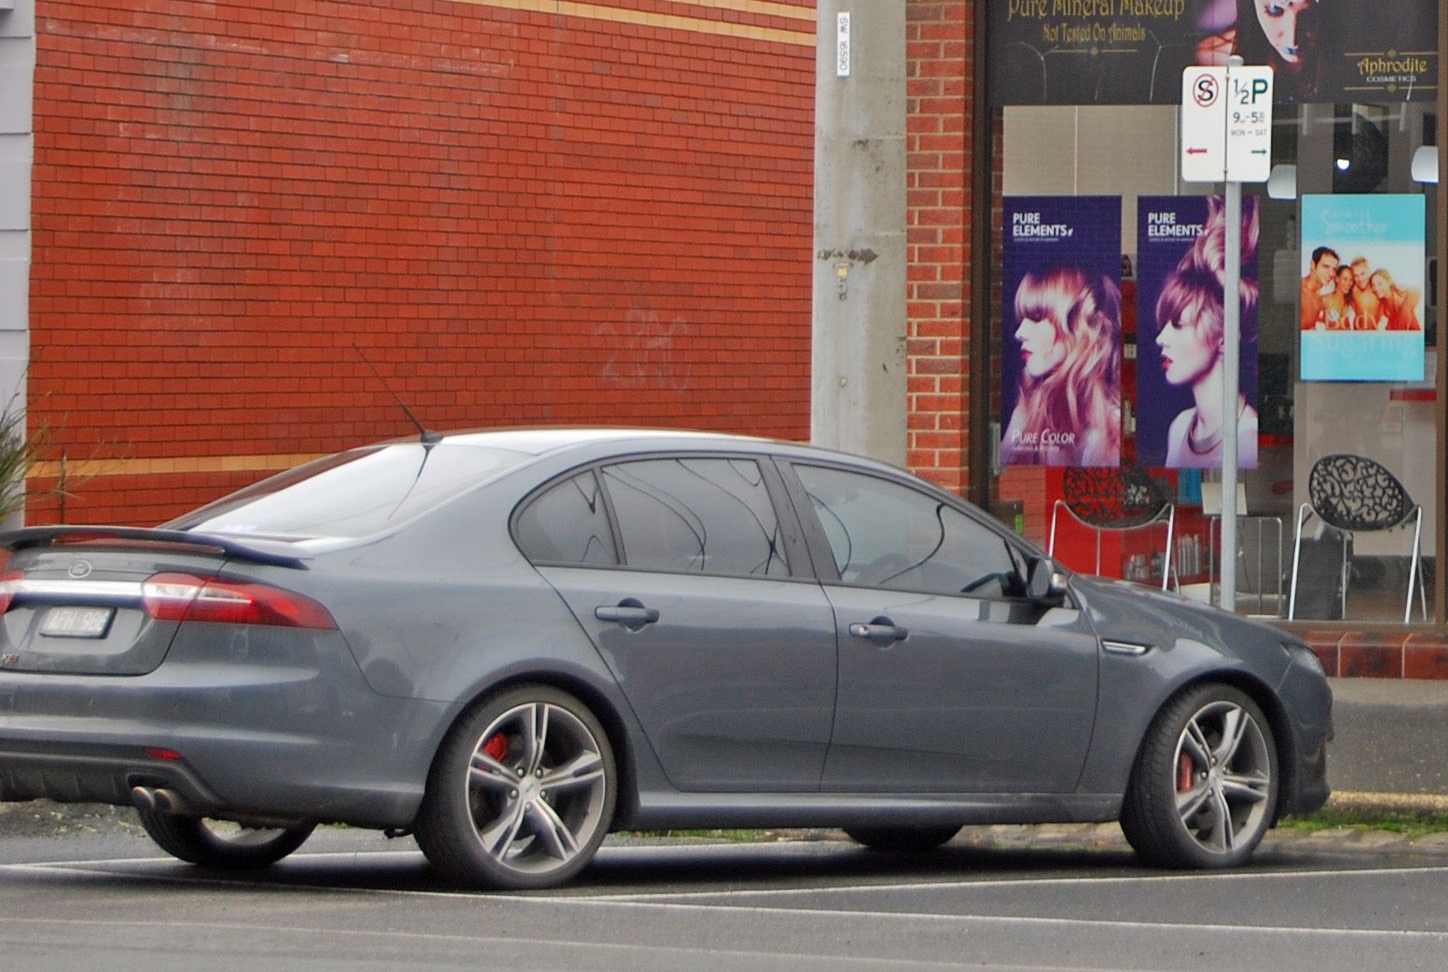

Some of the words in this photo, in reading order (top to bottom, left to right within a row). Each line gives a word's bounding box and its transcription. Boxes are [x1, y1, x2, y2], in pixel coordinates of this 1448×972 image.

[1043, 23, 1059, 41] Not
[1357, 57, 1429, 76] Aphrodite
[1366, 75, 1417, 83] COSMETICS
[1013, 212, 1040, 224] PURE
[1148, 212, 1176, 224] PURE
[1013, 224, 1068, 236] ELEMENTS
[1148, 224, 1203, 236] ELEMENTS
[1041, 428, 1076, 444] COLOR
